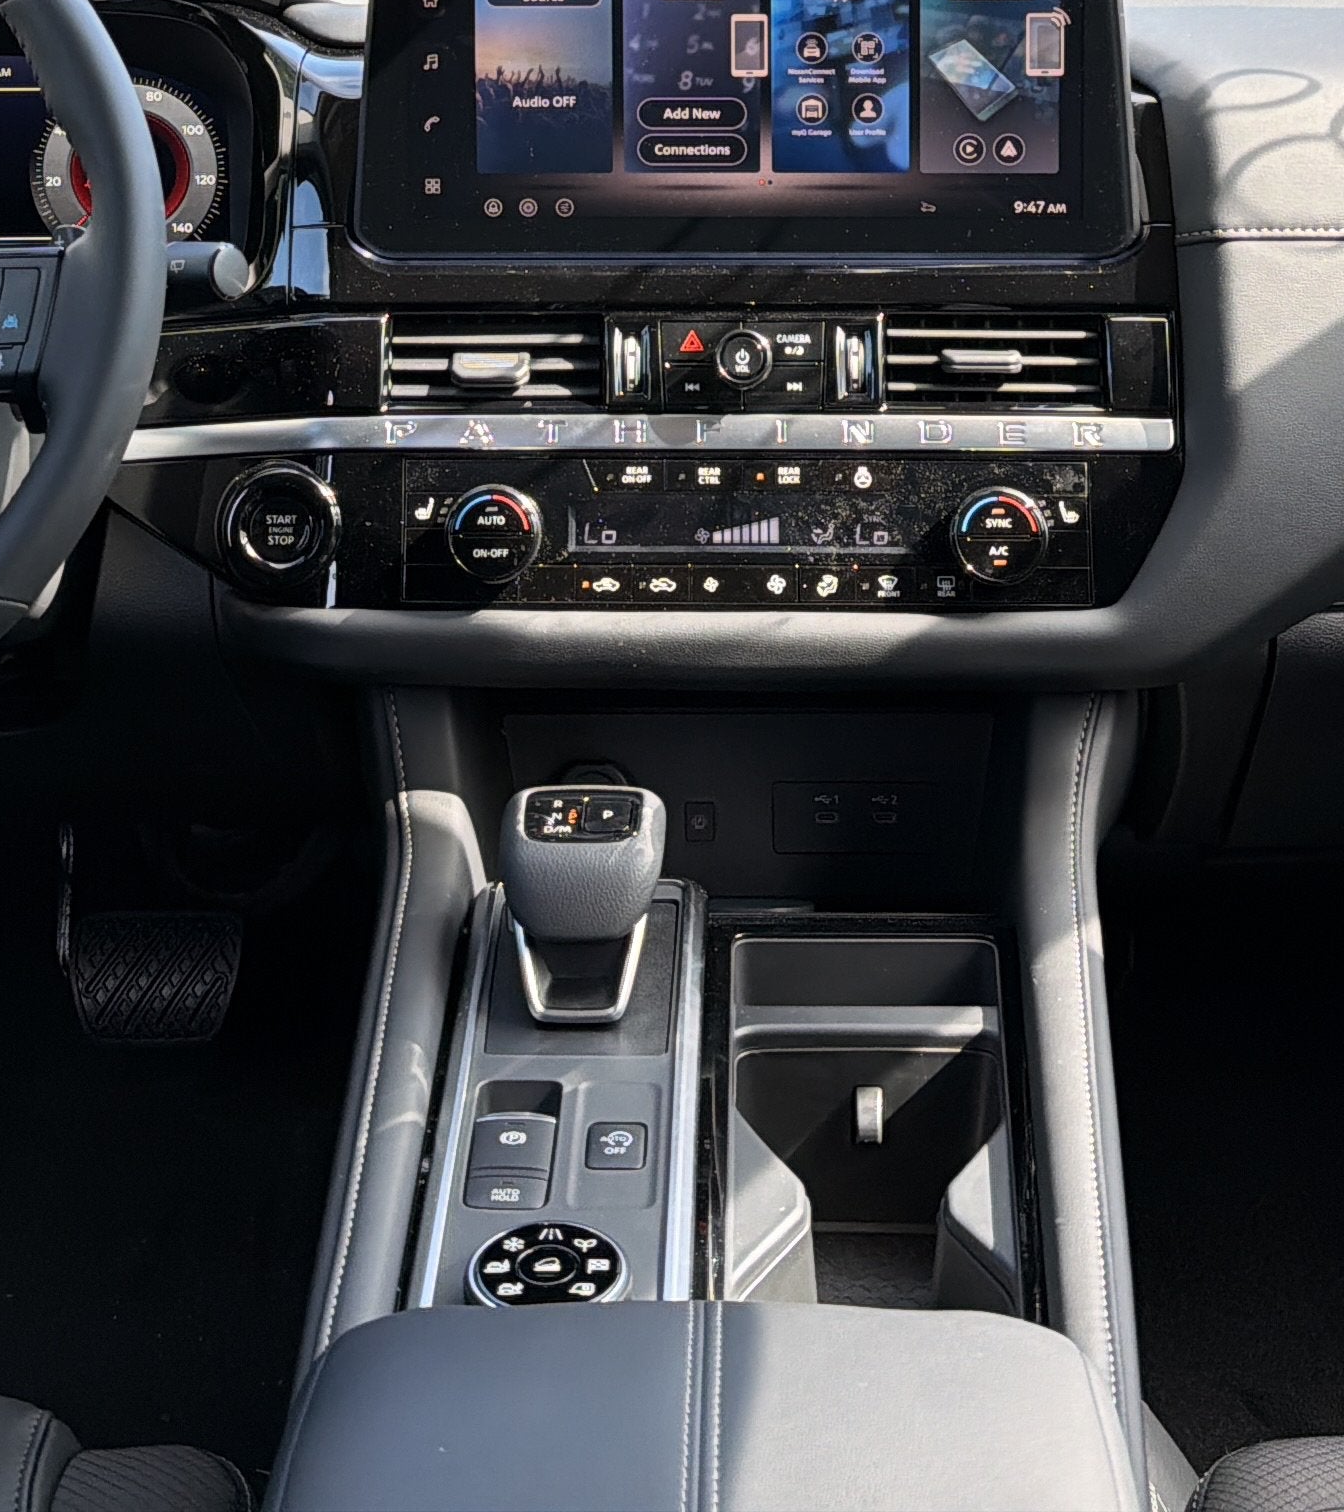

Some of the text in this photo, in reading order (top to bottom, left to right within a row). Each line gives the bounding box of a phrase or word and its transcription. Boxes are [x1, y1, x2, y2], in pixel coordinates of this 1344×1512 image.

[145, 91, 163, 102] 80
[512, 96, 577, 107] Audio OFF
[663, 107, 721, 119] Add New
[181, 125, 205, 135] 100
[654, 144, 731, 156] Connections
[45, 176, 62, 187] 20
[195, 174, 216, 185] 120
[1014, 200, 1067, 214] 9:47 AM
[171, 222, 194, 233] 140
[776, 333, 811, 344] CAMERA
[735, 364, 750, 373] VOL
[625, 466, 649, 475] REAR
[698, 467, 721, 476] REAR
[778, 466, 800, 475] REAR
[698, 476, 721, 485] CTRL
[778, 476, 801, 484] LOCK
[265, 514, 297, 525] START
[477, 515, 505, 526] AUTO
[985, 518, 1013, 529] SYNC
[268, 526, 294, 534] ENGINE
[267, 534, 295, 546] STOP
[989, 546, 1009, 556] A/C
[877, 590, 901, 598] FRONT
[553, 799, 564, 808] R
[551, 812, 563, 821] N
[602, 809, 615, 820] P
[604, 1146, 627, 1155] OFF
[490, 1188, 521, 1196] AUTO
[490, 1194, 520, 1202] HOLD
